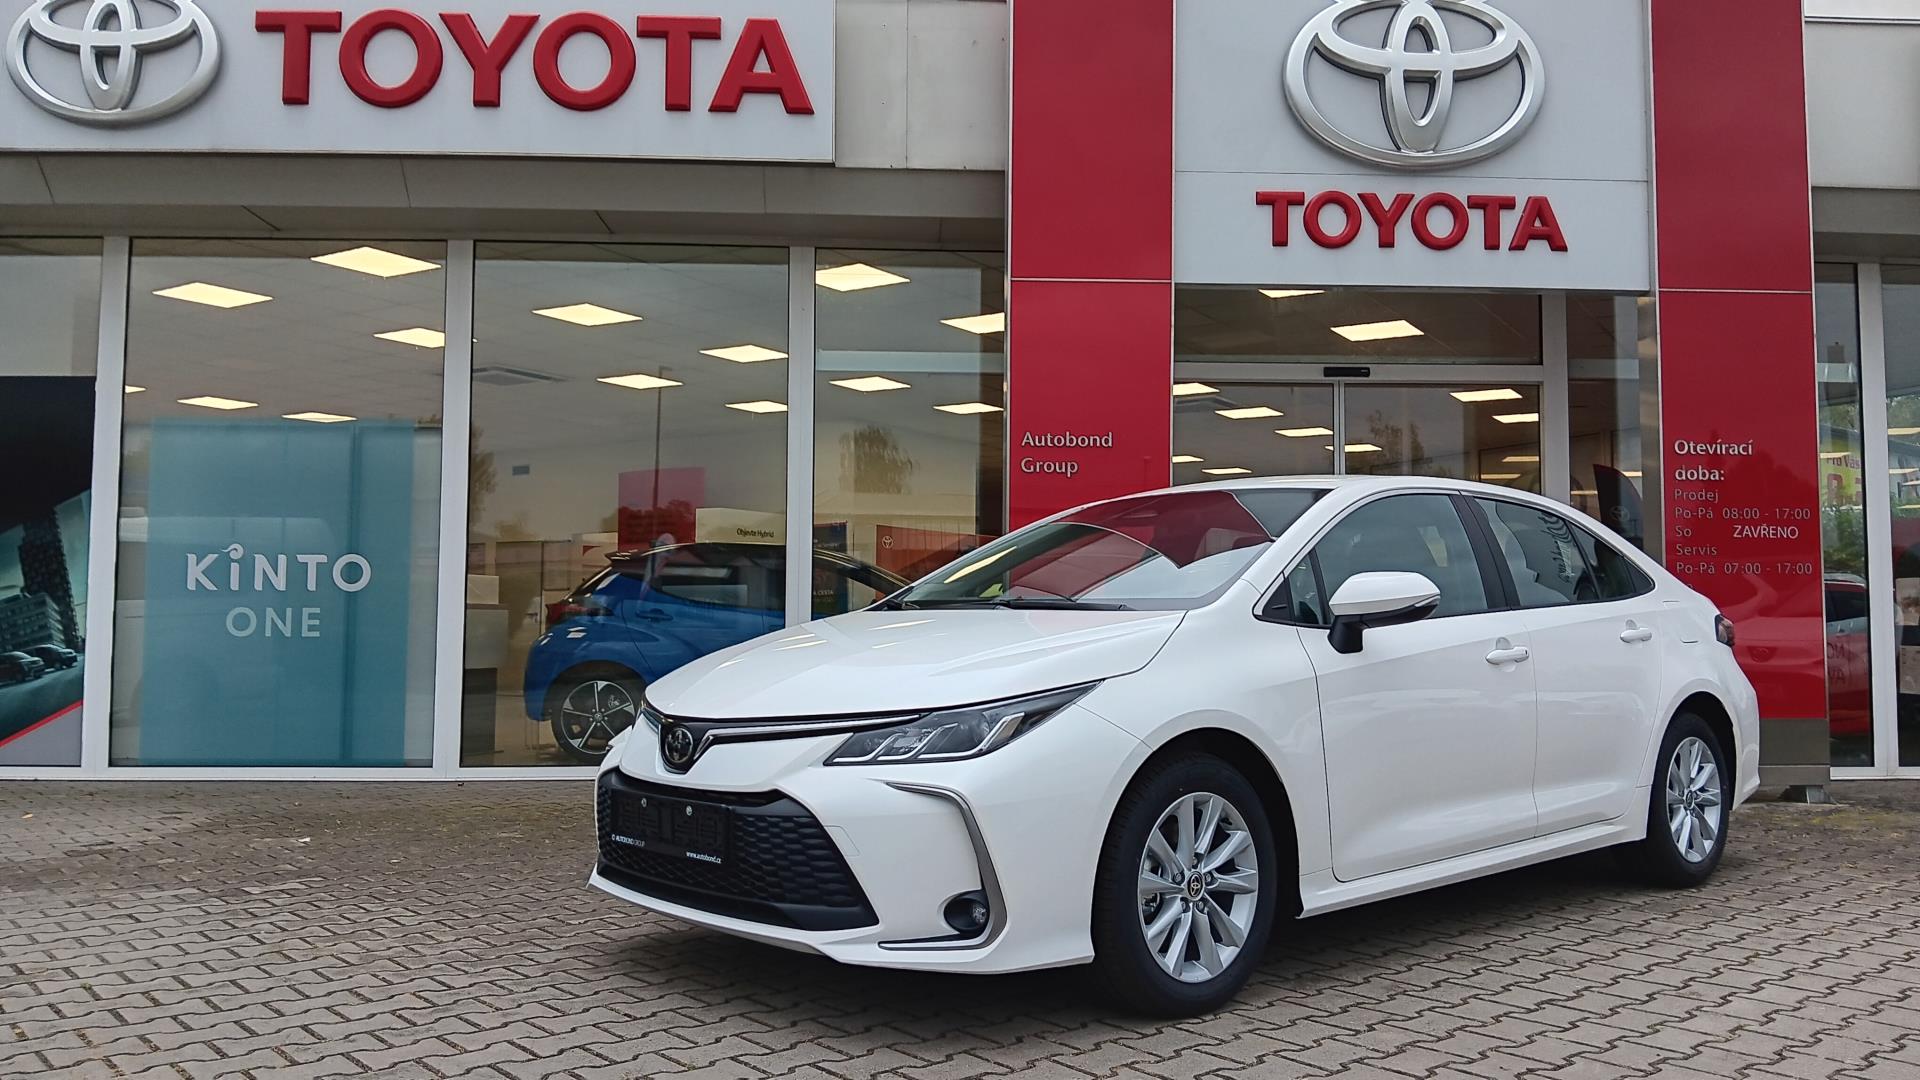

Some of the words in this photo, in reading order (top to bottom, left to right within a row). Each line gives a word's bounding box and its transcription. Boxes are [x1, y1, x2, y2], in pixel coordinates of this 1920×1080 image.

[255, 8, 816, 115] TOYOTA
[1255, 190, 1569, 252] TOYOTA
[1021, 431, 1113, 448] Autobond
[1674, 438, 1754, 456] Otevírací
[1020, 457, 1079, 478] Group
[1675, 464, 1725, 481] doba:
[1674, 488, 1719, 503] Prodej
[1675, 507, 1714, 519] Po-Pá
[1722, 507, 1760, 520] 08:00
[1775, 508, 1811, 520] 17:00
[1675, 525, 1692, 537] So
[1732, 523, 1799, 539] ZAVŘENO
[1676, 543, 1718, 556] Servis
[1676, 562, 1715, 575] Po-Pá
[1724, 562, 1761, 575] 07:00
[1776, 563, 1813, 575] 17:00
[225, 606, 321, 638] ONE
